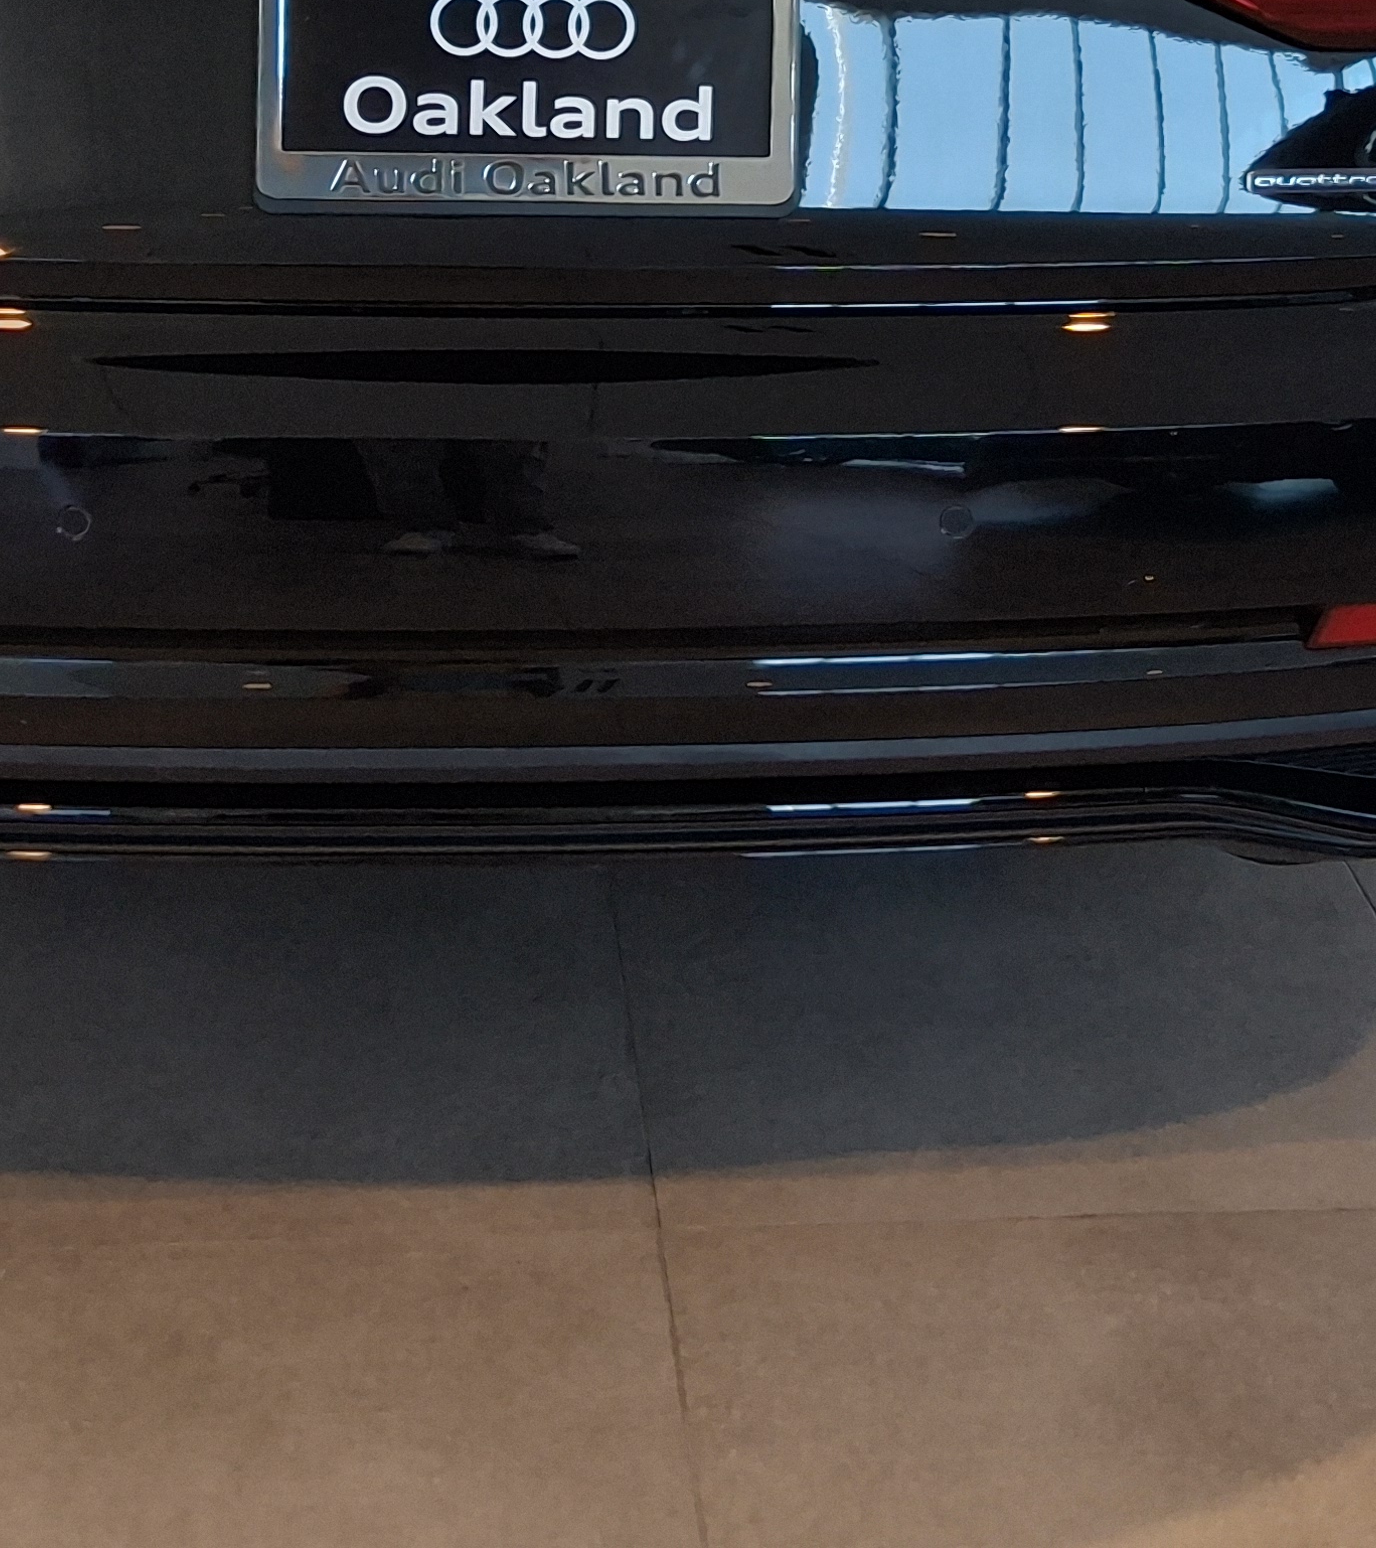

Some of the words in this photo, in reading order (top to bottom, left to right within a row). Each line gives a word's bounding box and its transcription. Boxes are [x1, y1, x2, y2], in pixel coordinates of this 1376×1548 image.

[342, 74, 714, 143] Oakland
[329, 156, 465, 198] Audi
[481, 158, 722, 199] Oakland
